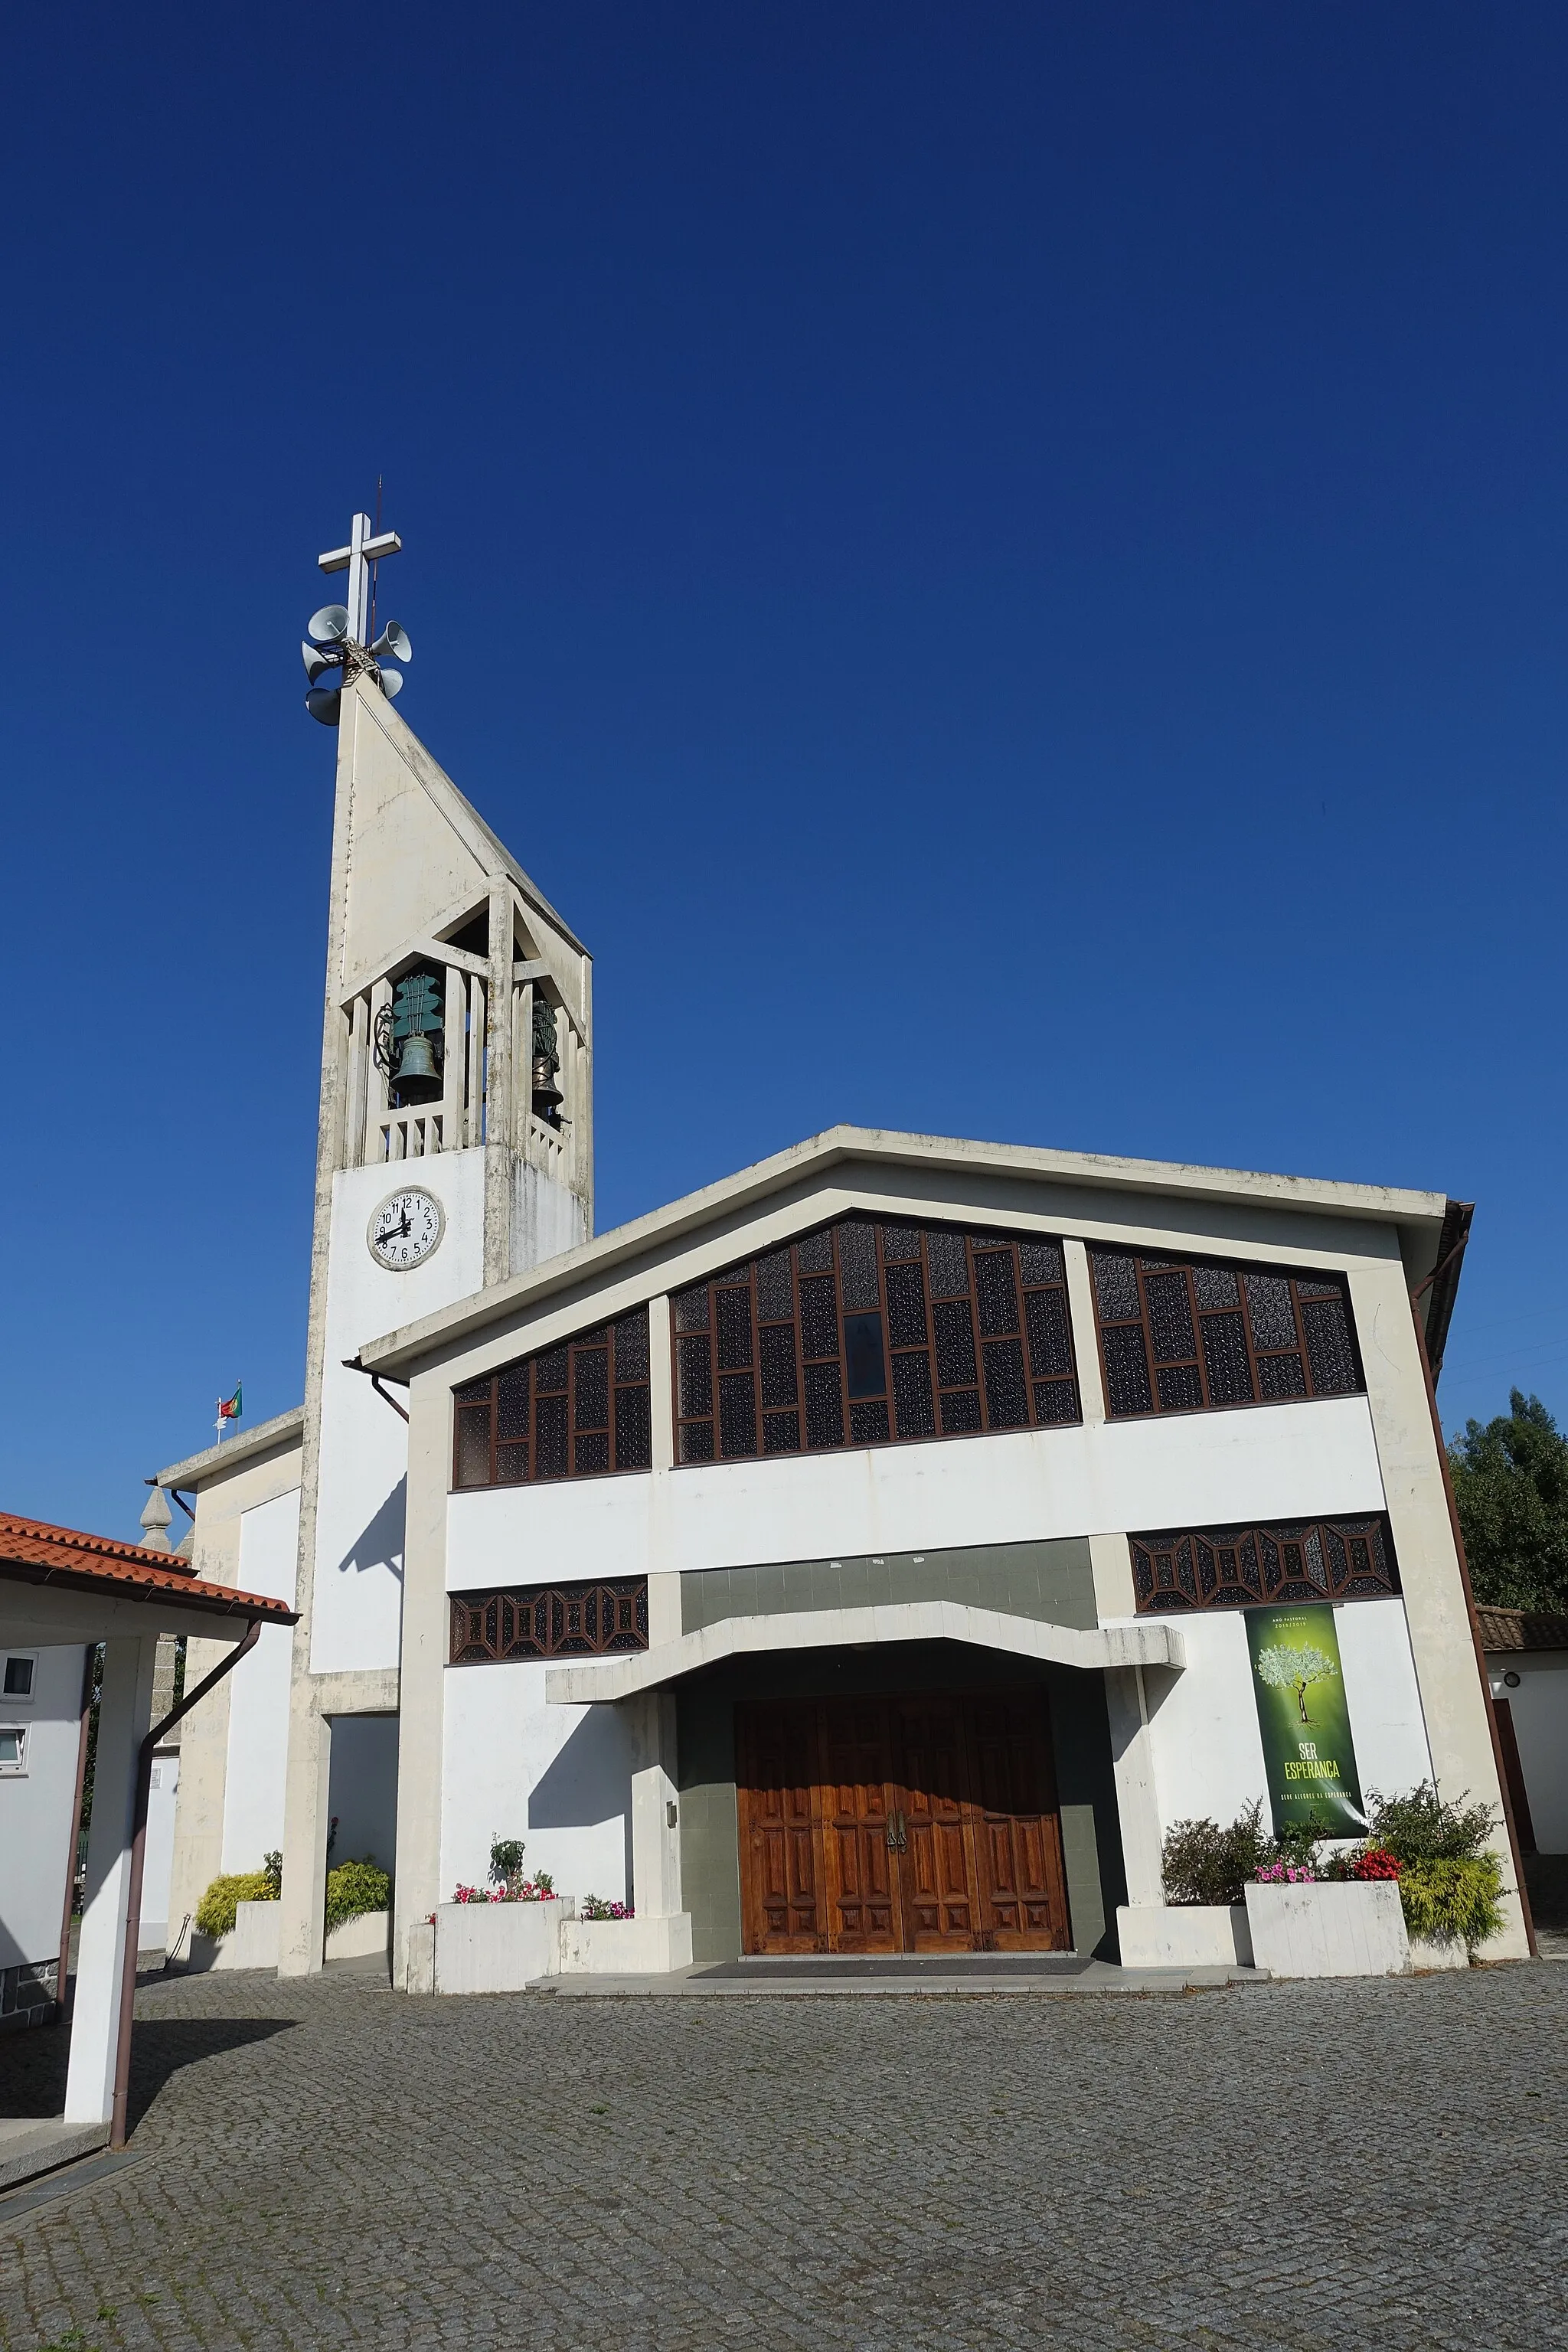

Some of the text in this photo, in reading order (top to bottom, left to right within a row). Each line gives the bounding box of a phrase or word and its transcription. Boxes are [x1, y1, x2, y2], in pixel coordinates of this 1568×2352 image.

[391, 1203, 399, 1214] 11
[402, 1197, 412, 1209] 12
[416, 1199, 420, 1210] 1
[423, 1207, 430, 1218] 2
[383, 1214, 391, 1225] 10
[426, 1218, 433, 1230] 3
[421, 1232, 428, 1243] 4
[390, 1246, 397, 1258] 7
[401, 1247, 408, 1259] 6
[413, 1243, 420, 1254] 5
[1298, 1743, 1318, 1760] SER
[1284, 1760, 1341, 1780] ESPERANÇA
